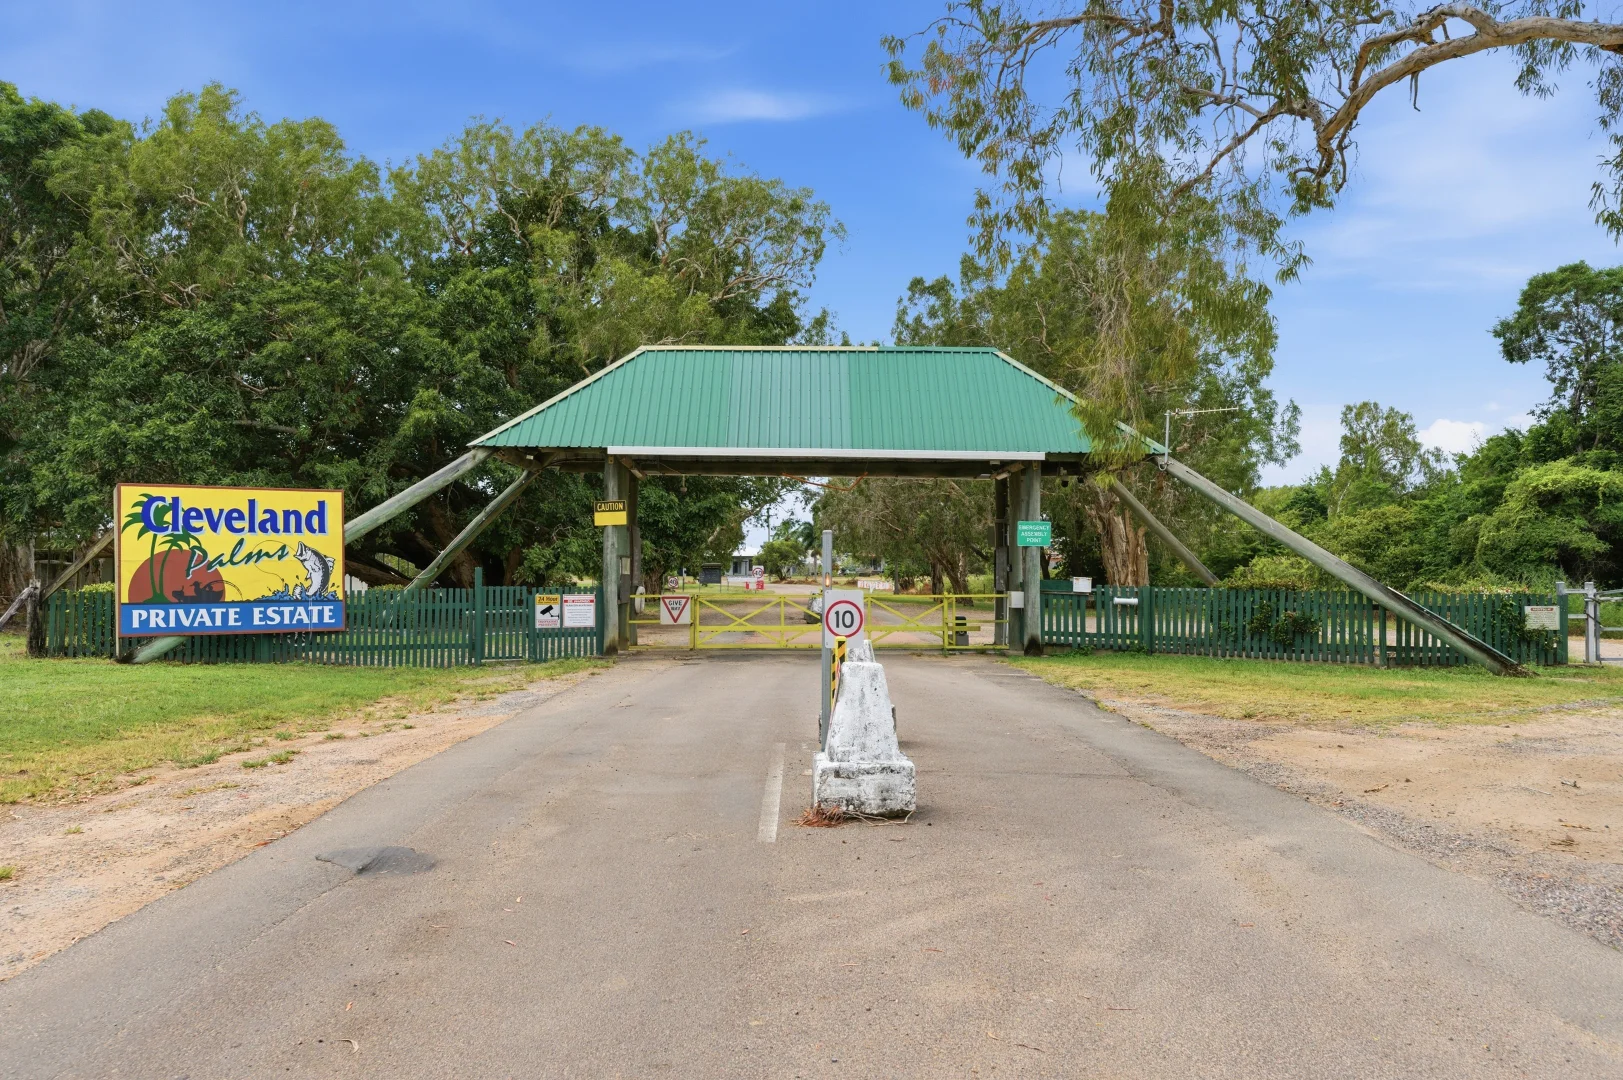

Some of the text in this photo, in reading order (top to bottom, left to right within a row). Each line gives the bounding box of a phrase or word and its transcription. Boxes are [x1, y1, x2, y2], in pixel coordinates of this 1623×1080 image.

[141, 496, 327, 535] Cleveland
[597, 502, 624, 511] CAUTION
[185, 537, 290, 579] Palms
[131, 605, 336, 628] PRIVATE ESTATE
[834, 609, 855, 629] 10
